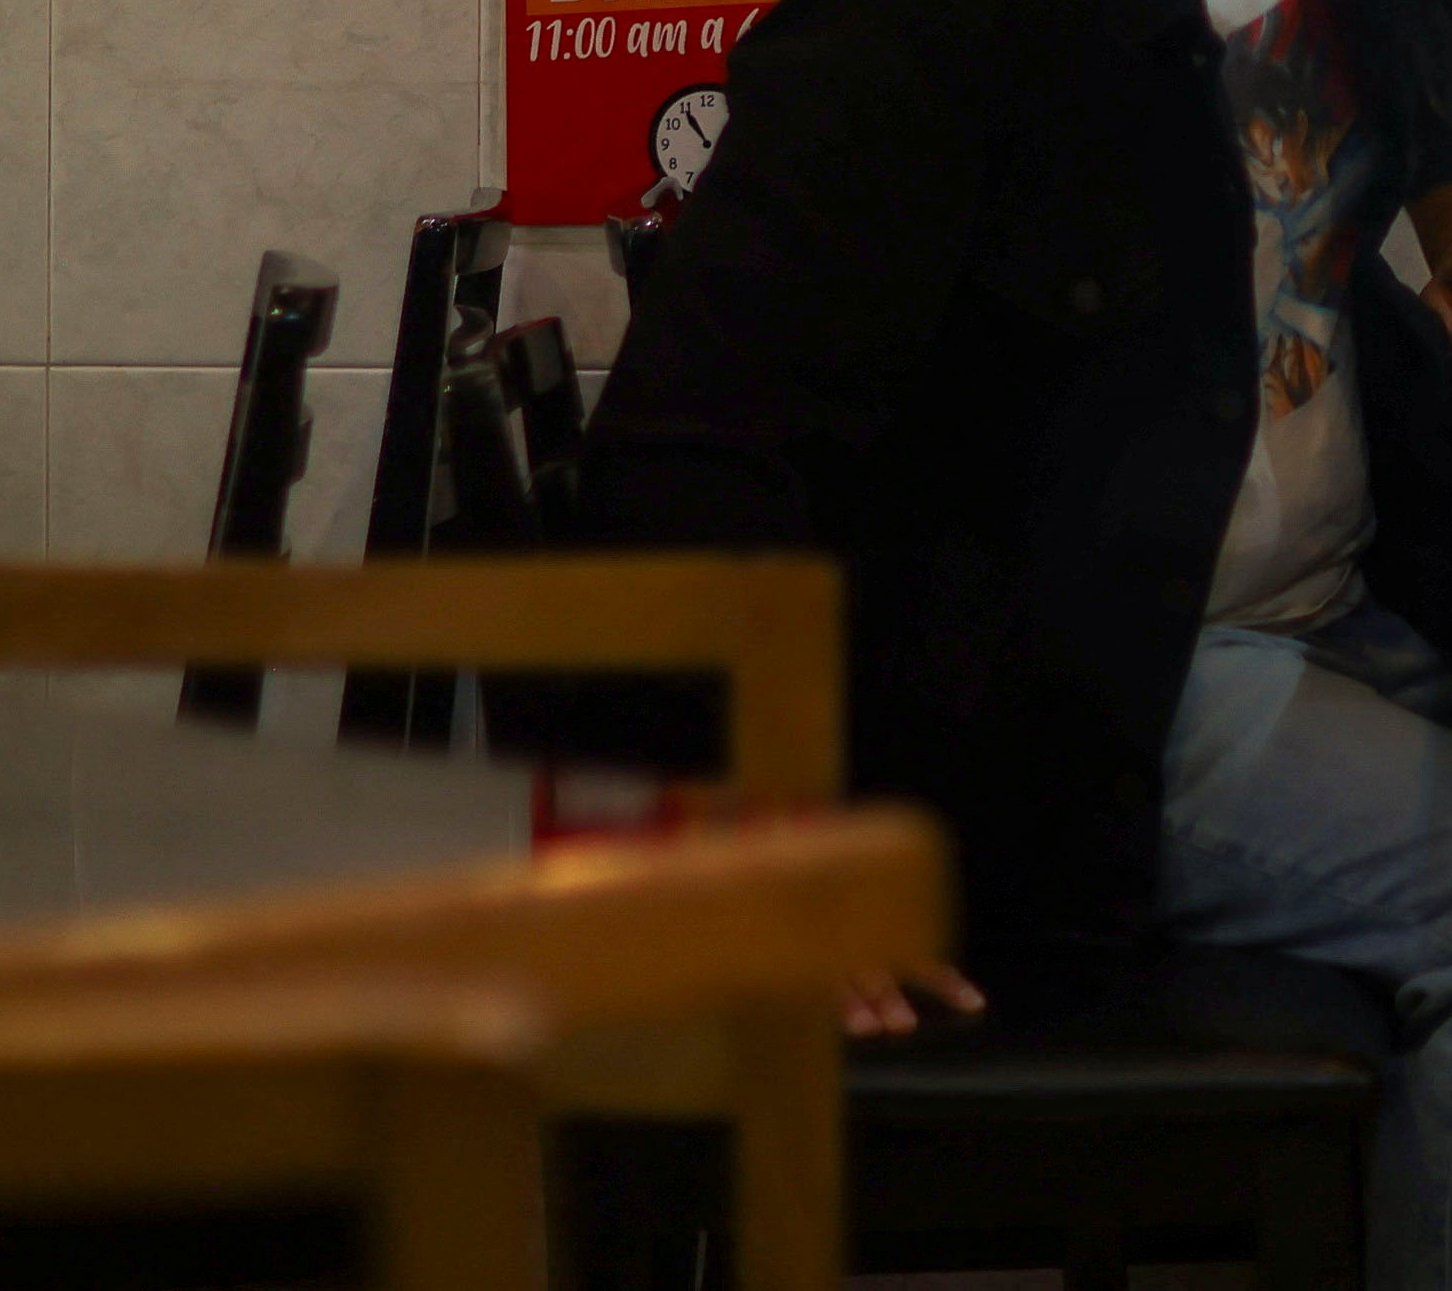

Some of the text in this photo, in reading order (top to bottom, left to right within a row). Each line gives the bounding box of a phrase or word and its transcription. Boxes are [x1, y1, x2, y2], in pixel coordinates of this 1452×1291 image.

[525, 16, 617, 63] 11:00
[627, 19, 688, 58] am
[700, 16, 725, 54] a
